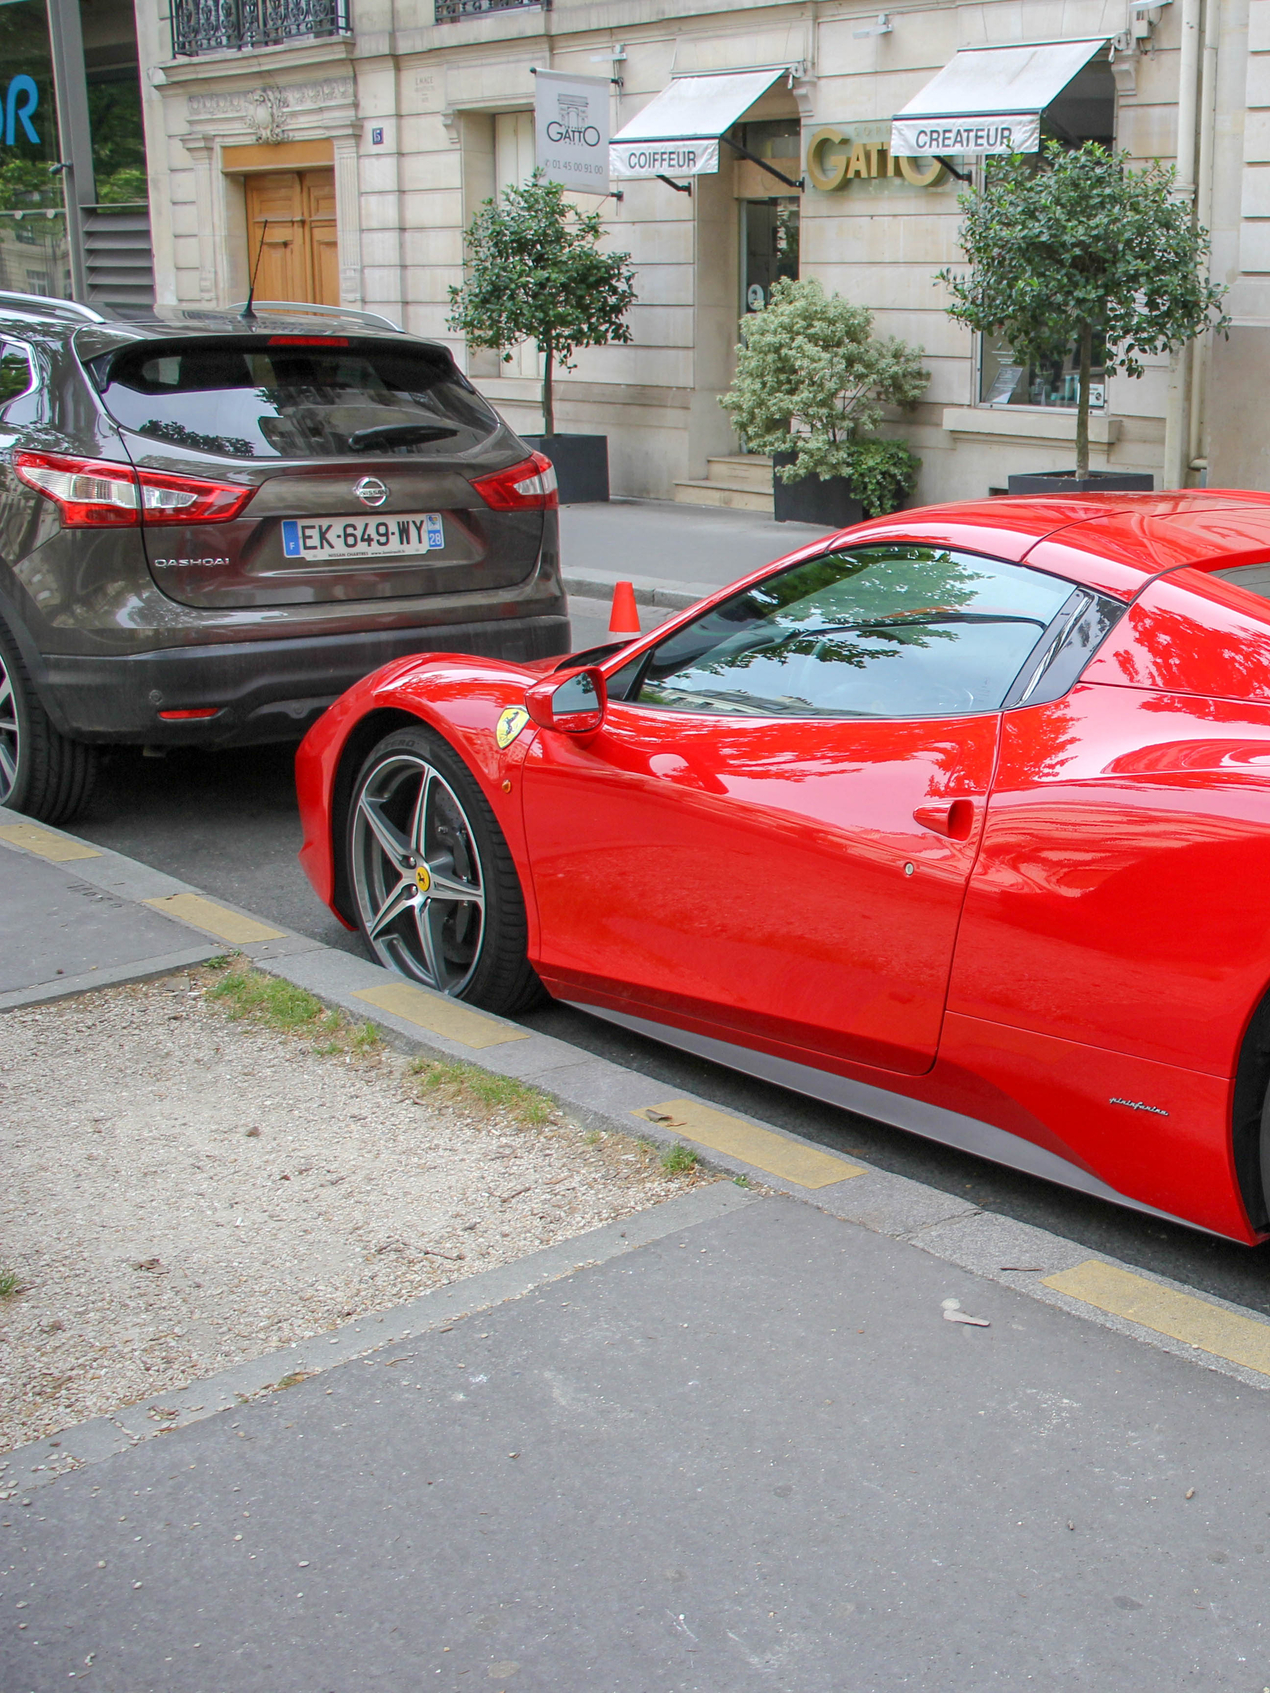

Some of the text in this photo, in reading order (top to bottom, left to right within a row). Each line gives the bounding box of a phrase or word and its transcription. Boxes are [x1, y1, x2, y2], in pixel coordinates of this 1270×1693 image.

[0, 74, 41, 146] R
[546, 121, 600, 147] GATTO
[915, 126, 1014, 149] CREATEUR
[552, 159, 604, 175] 01 45 00 91 00
[628, 150, 697, 169] COIFFEUR
[301, 520, 425, 550] EK-649-WY
[430, 533, 441, 545] 28
[290, 542, 295, 550] F
[154, 558, 230, 568] QASHQAI
